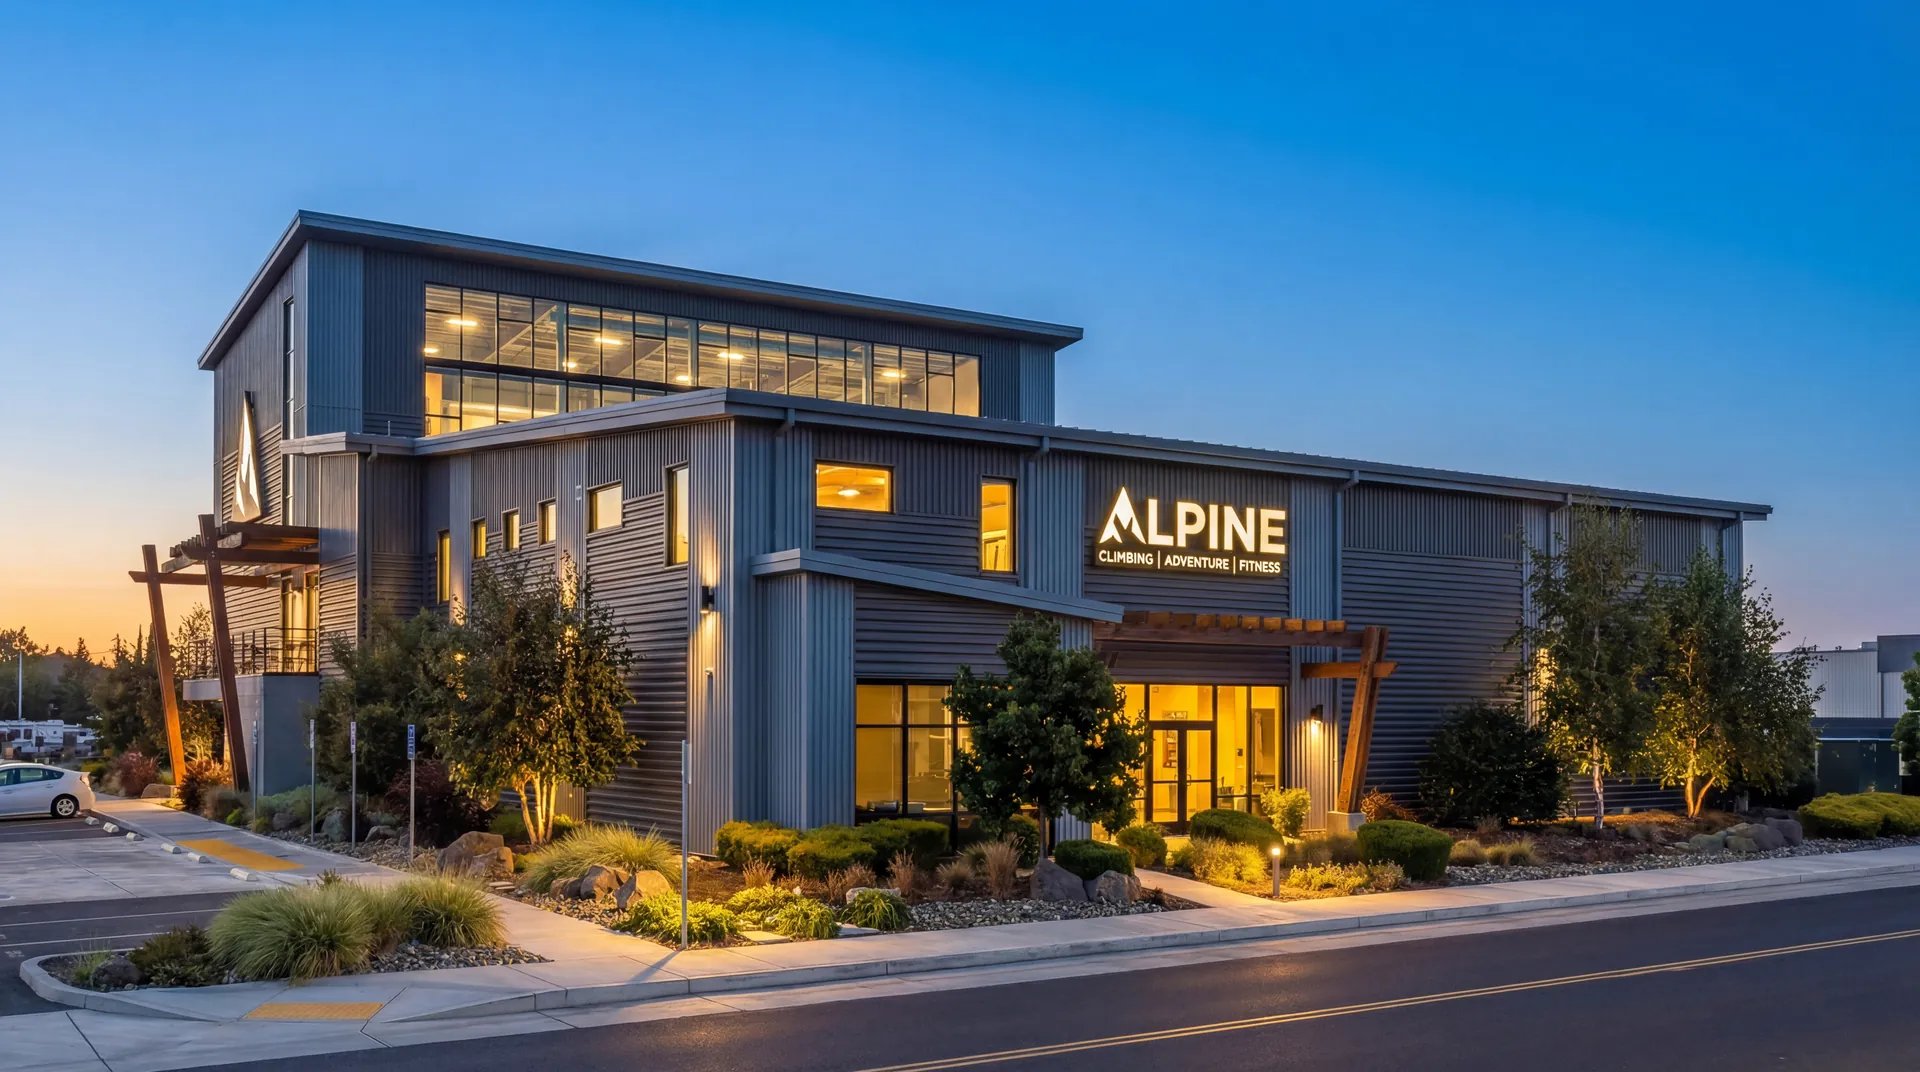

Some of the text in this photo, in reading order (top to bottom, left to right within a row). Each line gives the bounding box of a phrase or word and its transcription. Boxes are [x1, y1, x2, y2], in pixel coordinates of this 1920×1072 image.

[1099, 486, 1286, 554] ALPINE
[1098, 550, 1281, 574] CLIMBING ADVENTURE FITNESS
